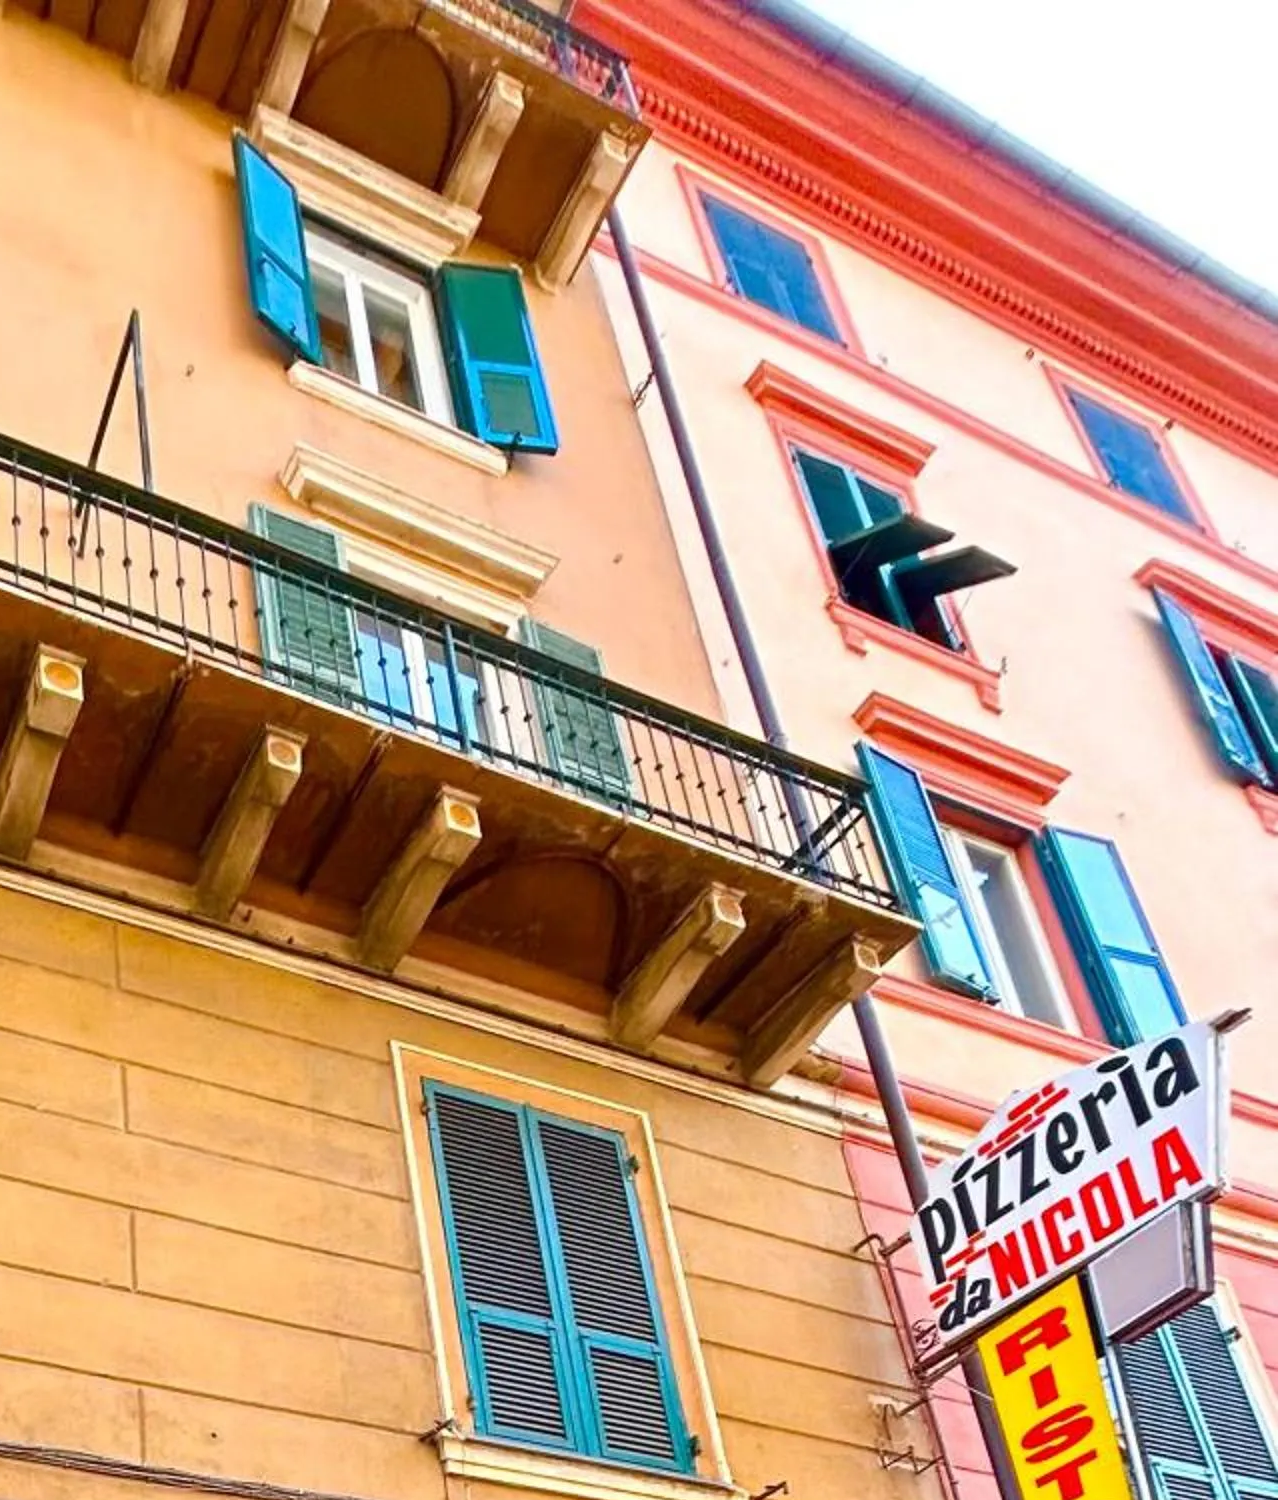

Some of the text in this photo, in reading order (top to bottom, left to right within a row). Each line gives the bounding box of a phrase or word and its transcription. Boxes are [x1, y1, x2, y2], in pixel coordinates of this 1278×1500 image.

[918, 1037, 1200, 1284] pizzeria
[939, 1126, 1203, 1333] da NICOLA
